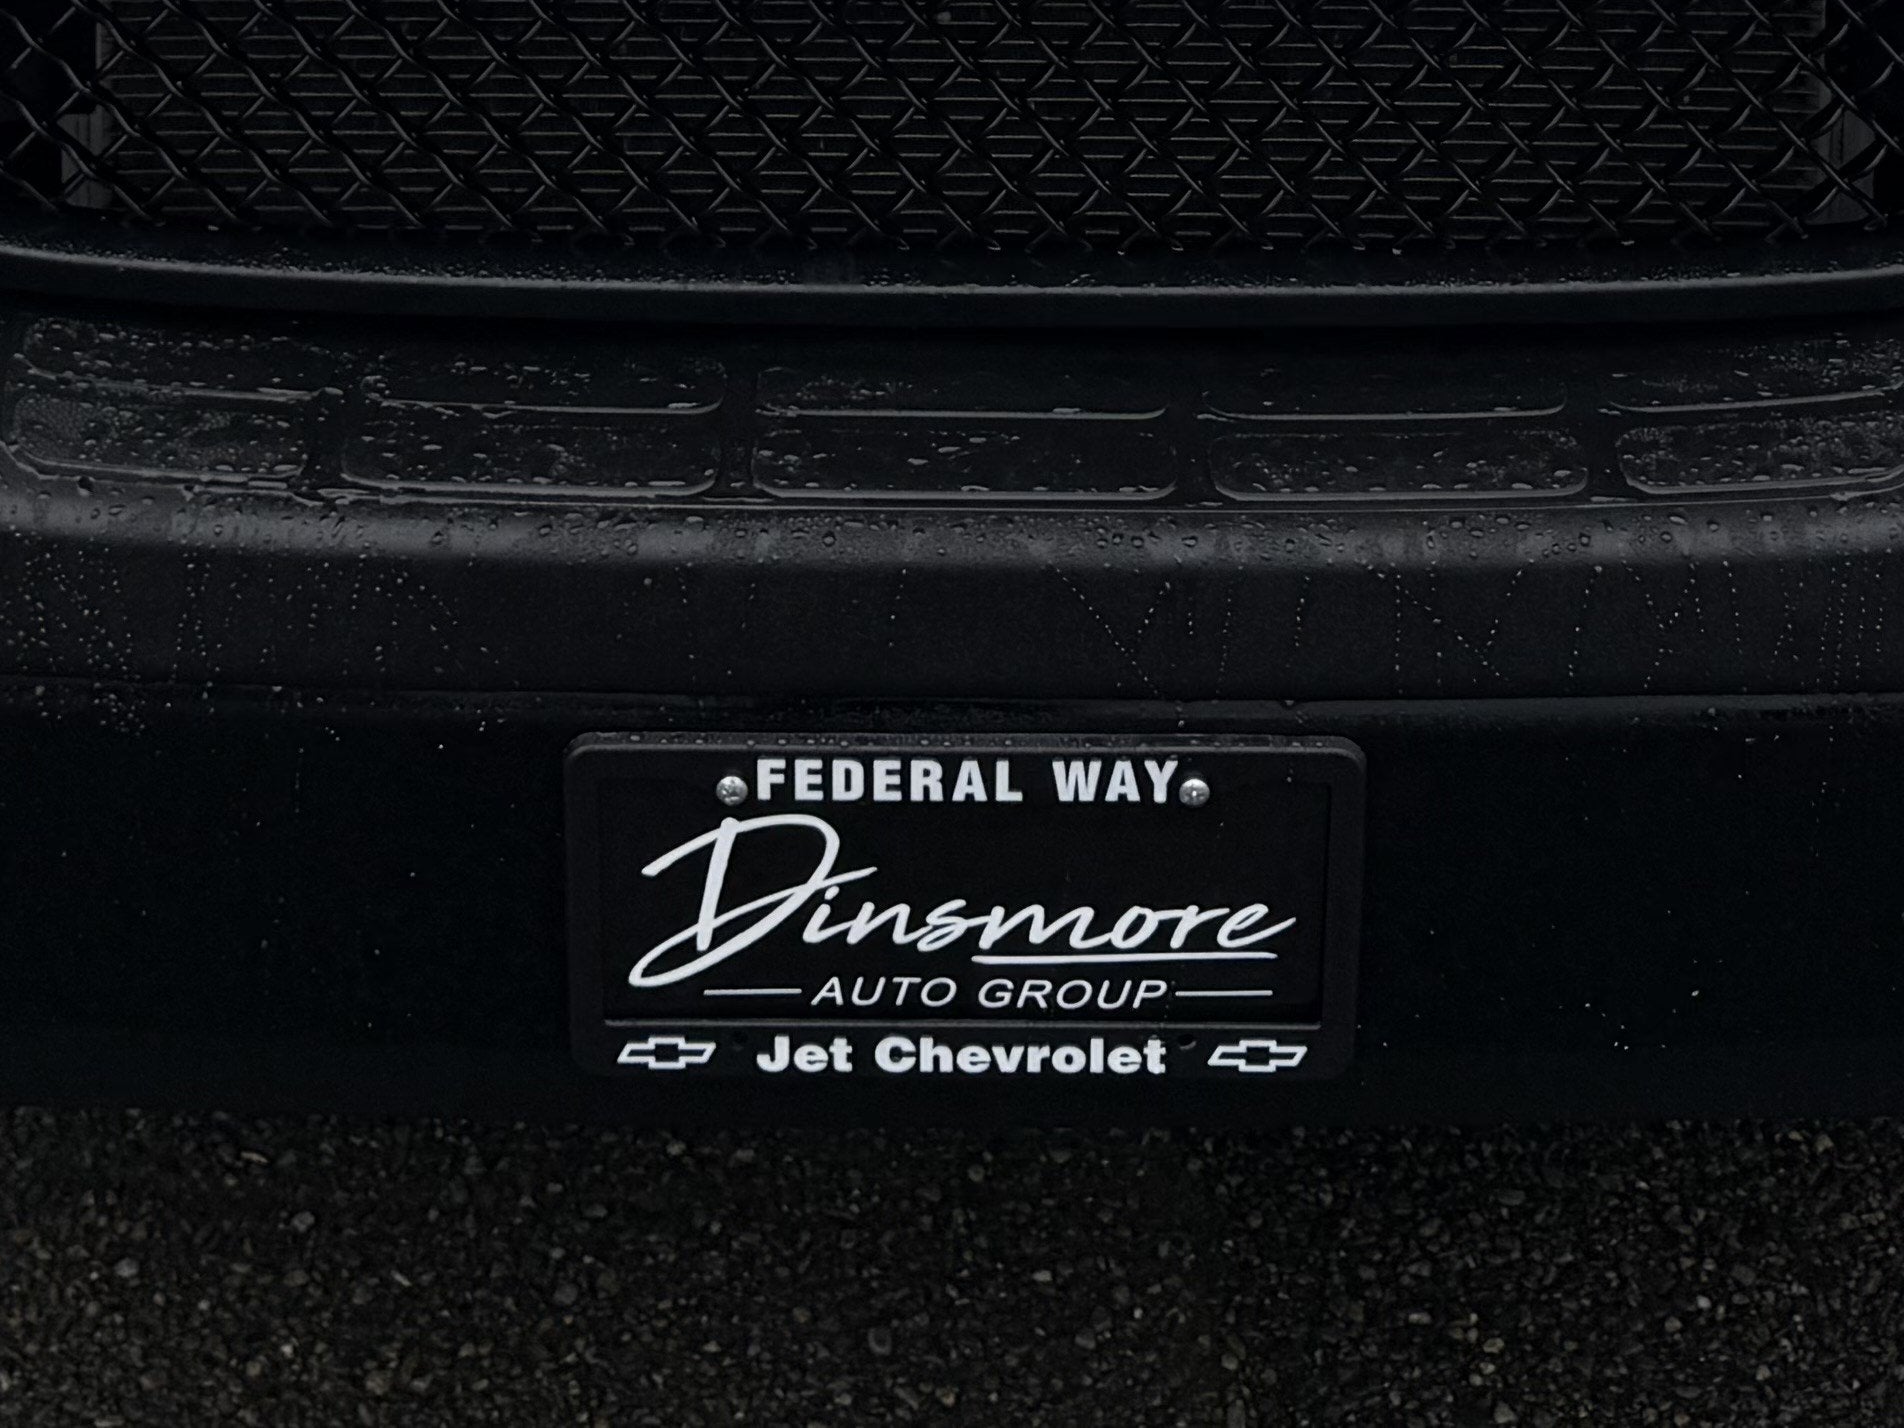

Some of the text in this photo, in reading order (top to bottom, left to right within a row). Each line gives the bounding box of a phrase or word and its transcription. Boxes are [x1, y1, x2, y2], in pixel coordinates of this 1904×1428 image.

[756, 758, 1179, 804] FEDERAL WAY
[628, 813, 1297, 989] Dinsmore
[810, 976, 1168, 1009] AUTO GROUP
[756, 1035, 1167, 1075] Jet Chevrolet
